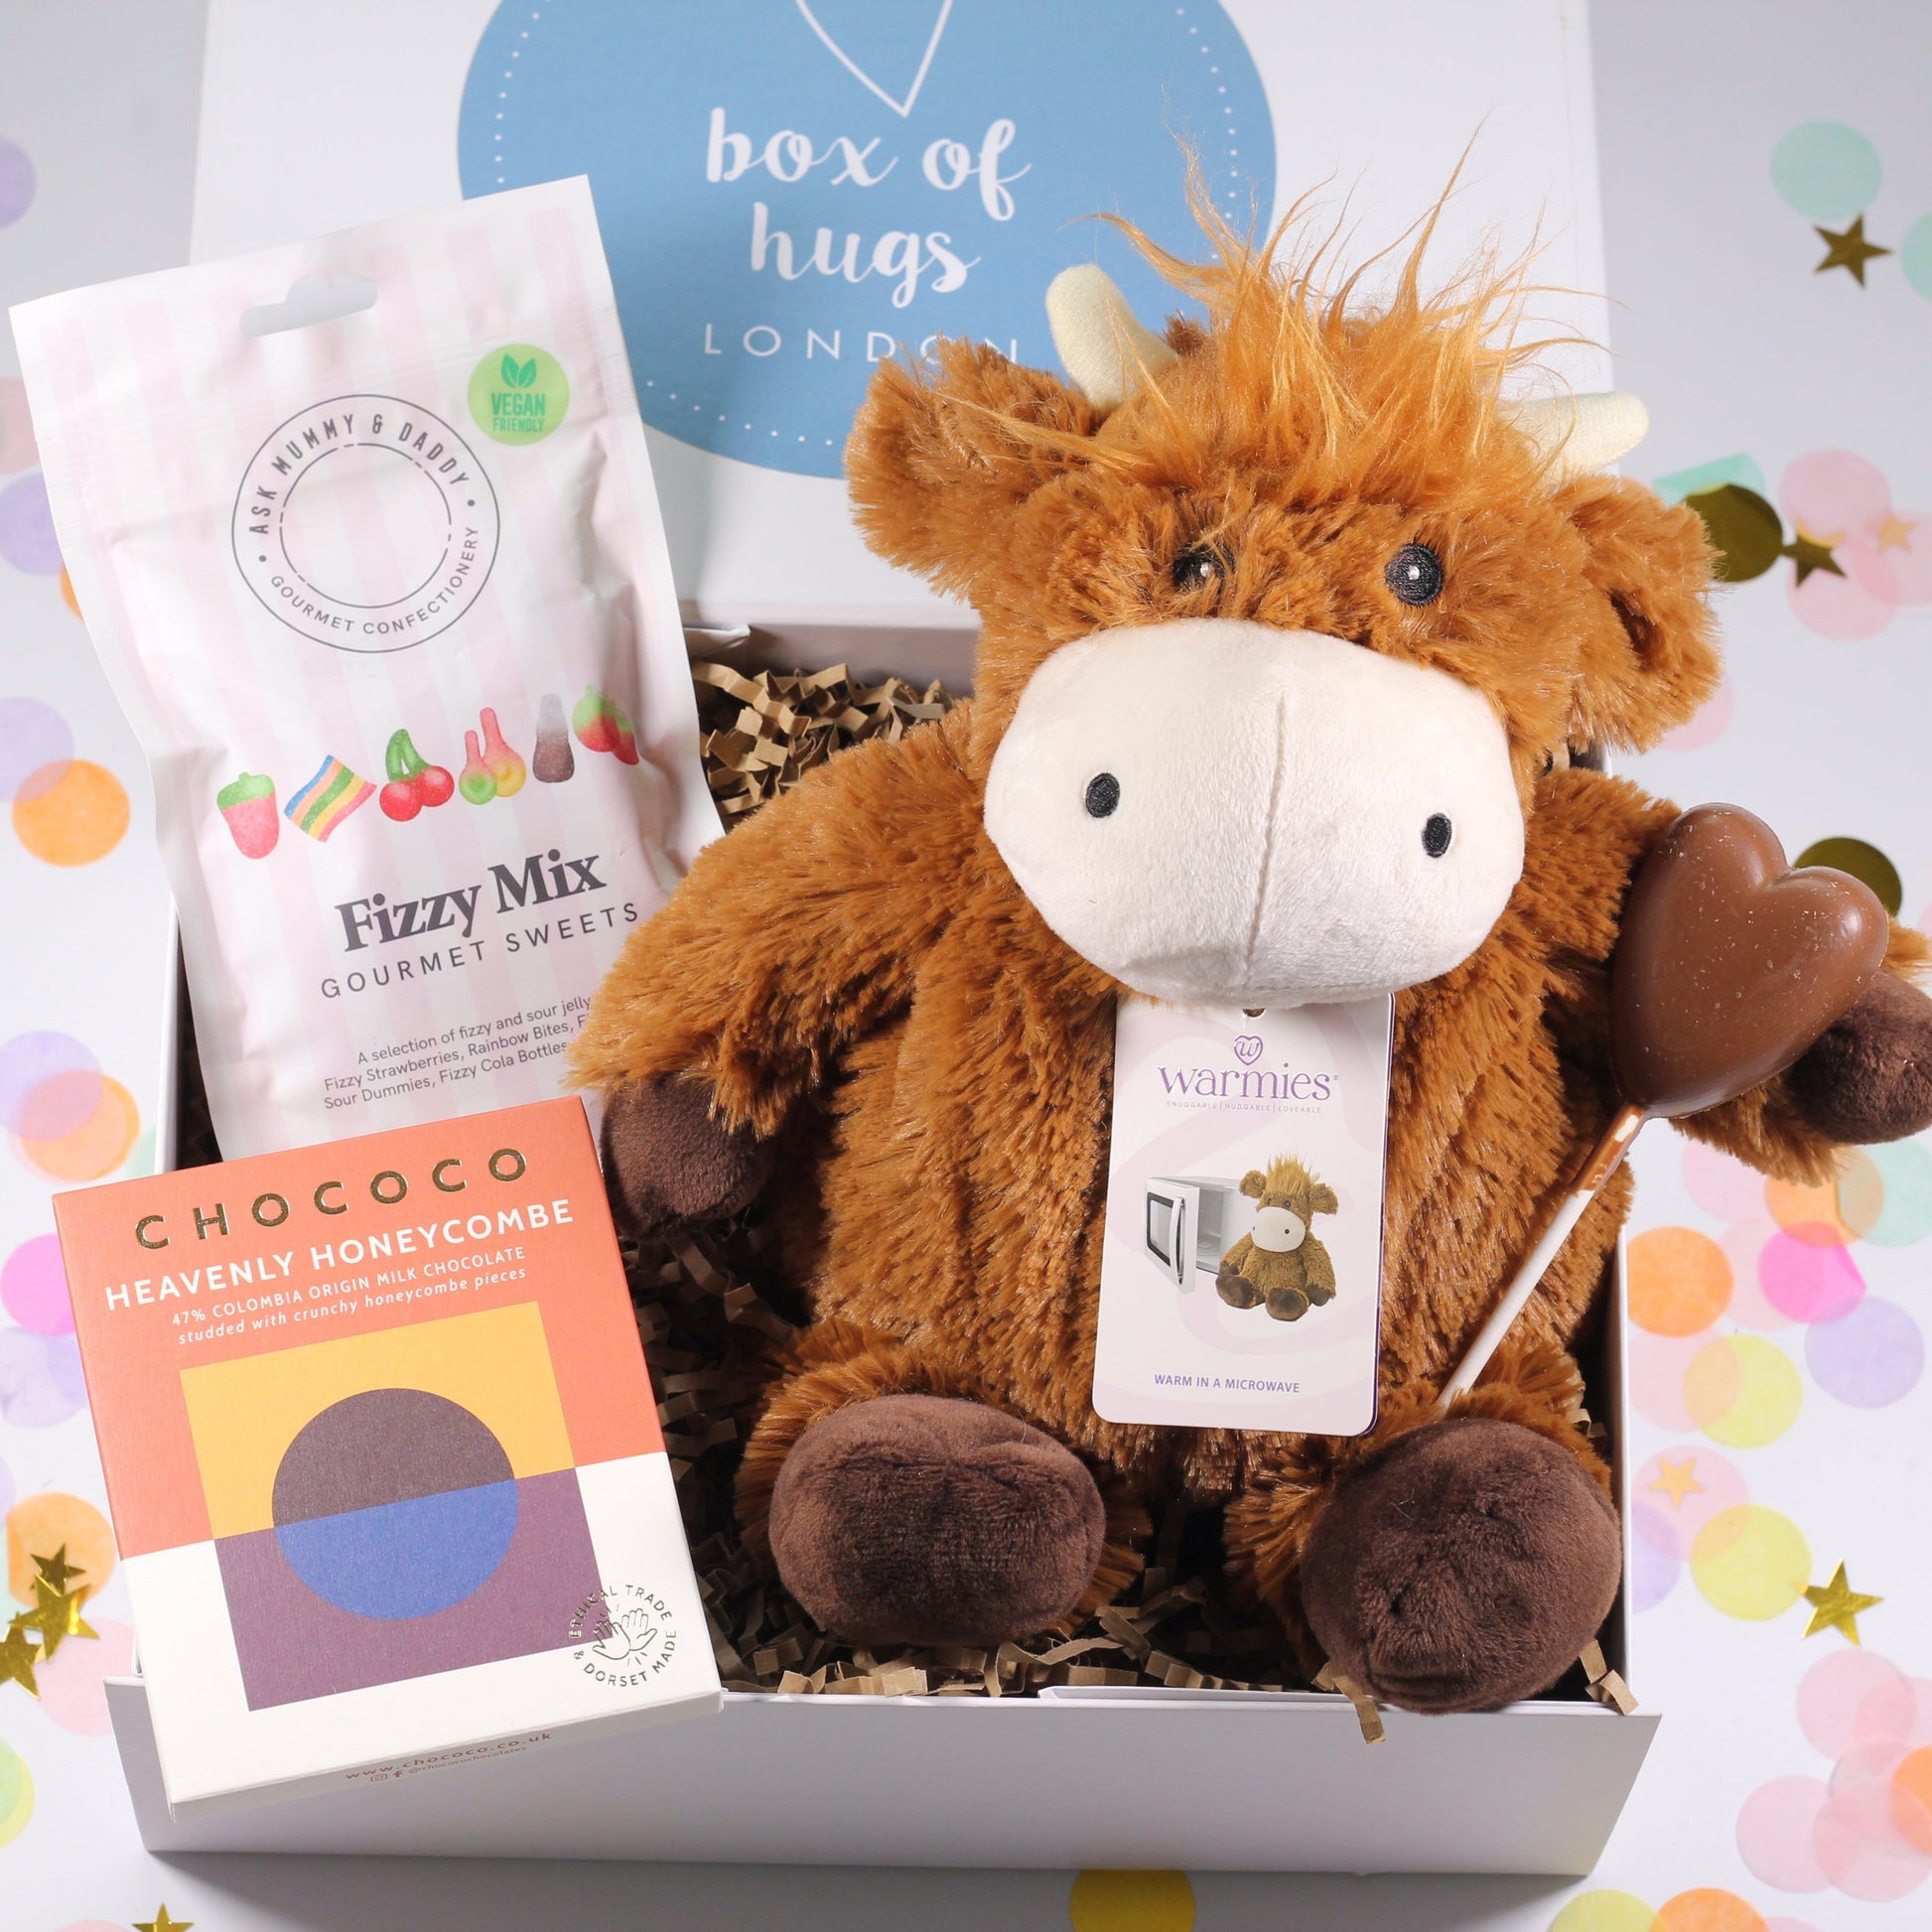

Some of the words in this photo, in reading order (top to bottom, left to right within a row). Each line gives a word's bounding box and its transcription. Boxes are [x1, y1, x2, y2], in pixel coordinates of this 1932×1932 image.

[706, 106, 898, 187] box
[922, 118, 1033, 220] of
[752, 202, 981, 309] hugs
[491, 392, 546, 416] VEGAN
[492, 418, 545, 433] FRIENDLY
[249, 485, 277, 534] ASK
[271, 413, 354, 476] MUMMY
[372, 414, 383, 434] &
[399, 422, 470, 484] DADDY
[271, 575, 355, 631] GOURMET
[363, 526, 479, 634] CONFECTIONERY
[334, 885, 483, 952] Fizzy
[487, 849, 607, 914] Mix
[321, 940, 486, 999] GOURMET
[505, 902, 638, 952] SWEETS
[324, 1073, 362, 1092] Fizzy
[366, 1049, 466, 1082] Strawberries,
[468, 1031, 529, 1056] Rainbow
[533, 1021, 574, 1039] Bites,
[357, 1052, 368, 1064] A
[371, 1037, 438, 1062] selection
[441, 1030, 457, 1044] of
[459, 1021, 492, 1039] fizzy
[496, 1013, 523, 1031] and
[526, 1006, 558, 1022] sour
[561, 996, 591, 1017] jelly
[324, 1093, 357, 1110] Sour
[361, 1075, 436, 1102] Dummies,
[439, 1064, 479, 1084] Fizzy
[481, 1054, 514, 1072] Cola
[135, 1148, 527, 1250] CHOCOCO
[105, 1251, 294, 1311] HEAVENLY
[311, 1199, 573, 1271] HONEYCOMBE
[172, 1310, 207, 1326] 47%
[212, 1291, 303, 1317] COLOMBIA
[309, 1276, 370, 1299] ORIGIN
[377, 1267, 418, 1287] MILK
[423, 1246, 525, 1277] CHOCOLATE
[179, 1318, 245, 1344] studded
[252, 1311, 287, 1330] with
[294, 1299, 357, 1322] crunchy
[364, 1279, 468, 1308] honeycombe
[475, 1268, 526, 1291] pieces
[1155, 1374, 1192, 1387] WARM
[1196, 1377, 1209, 1388] IN
[1212, 1378, 1221, 1388] A
[1225, 1379, 1301, 1393] MICROWAVE
[568, 1586, 618, 1638] ETHICAL
[625, 1585, 672, 1620] TRADE
[573, 1650, 585, 1660] &
[584, 1663, 647, 1687] DORSET
[651, 1630, 677, 1674] MADE
[345, 1733, 551, 1779] www.chococo.co.uk
